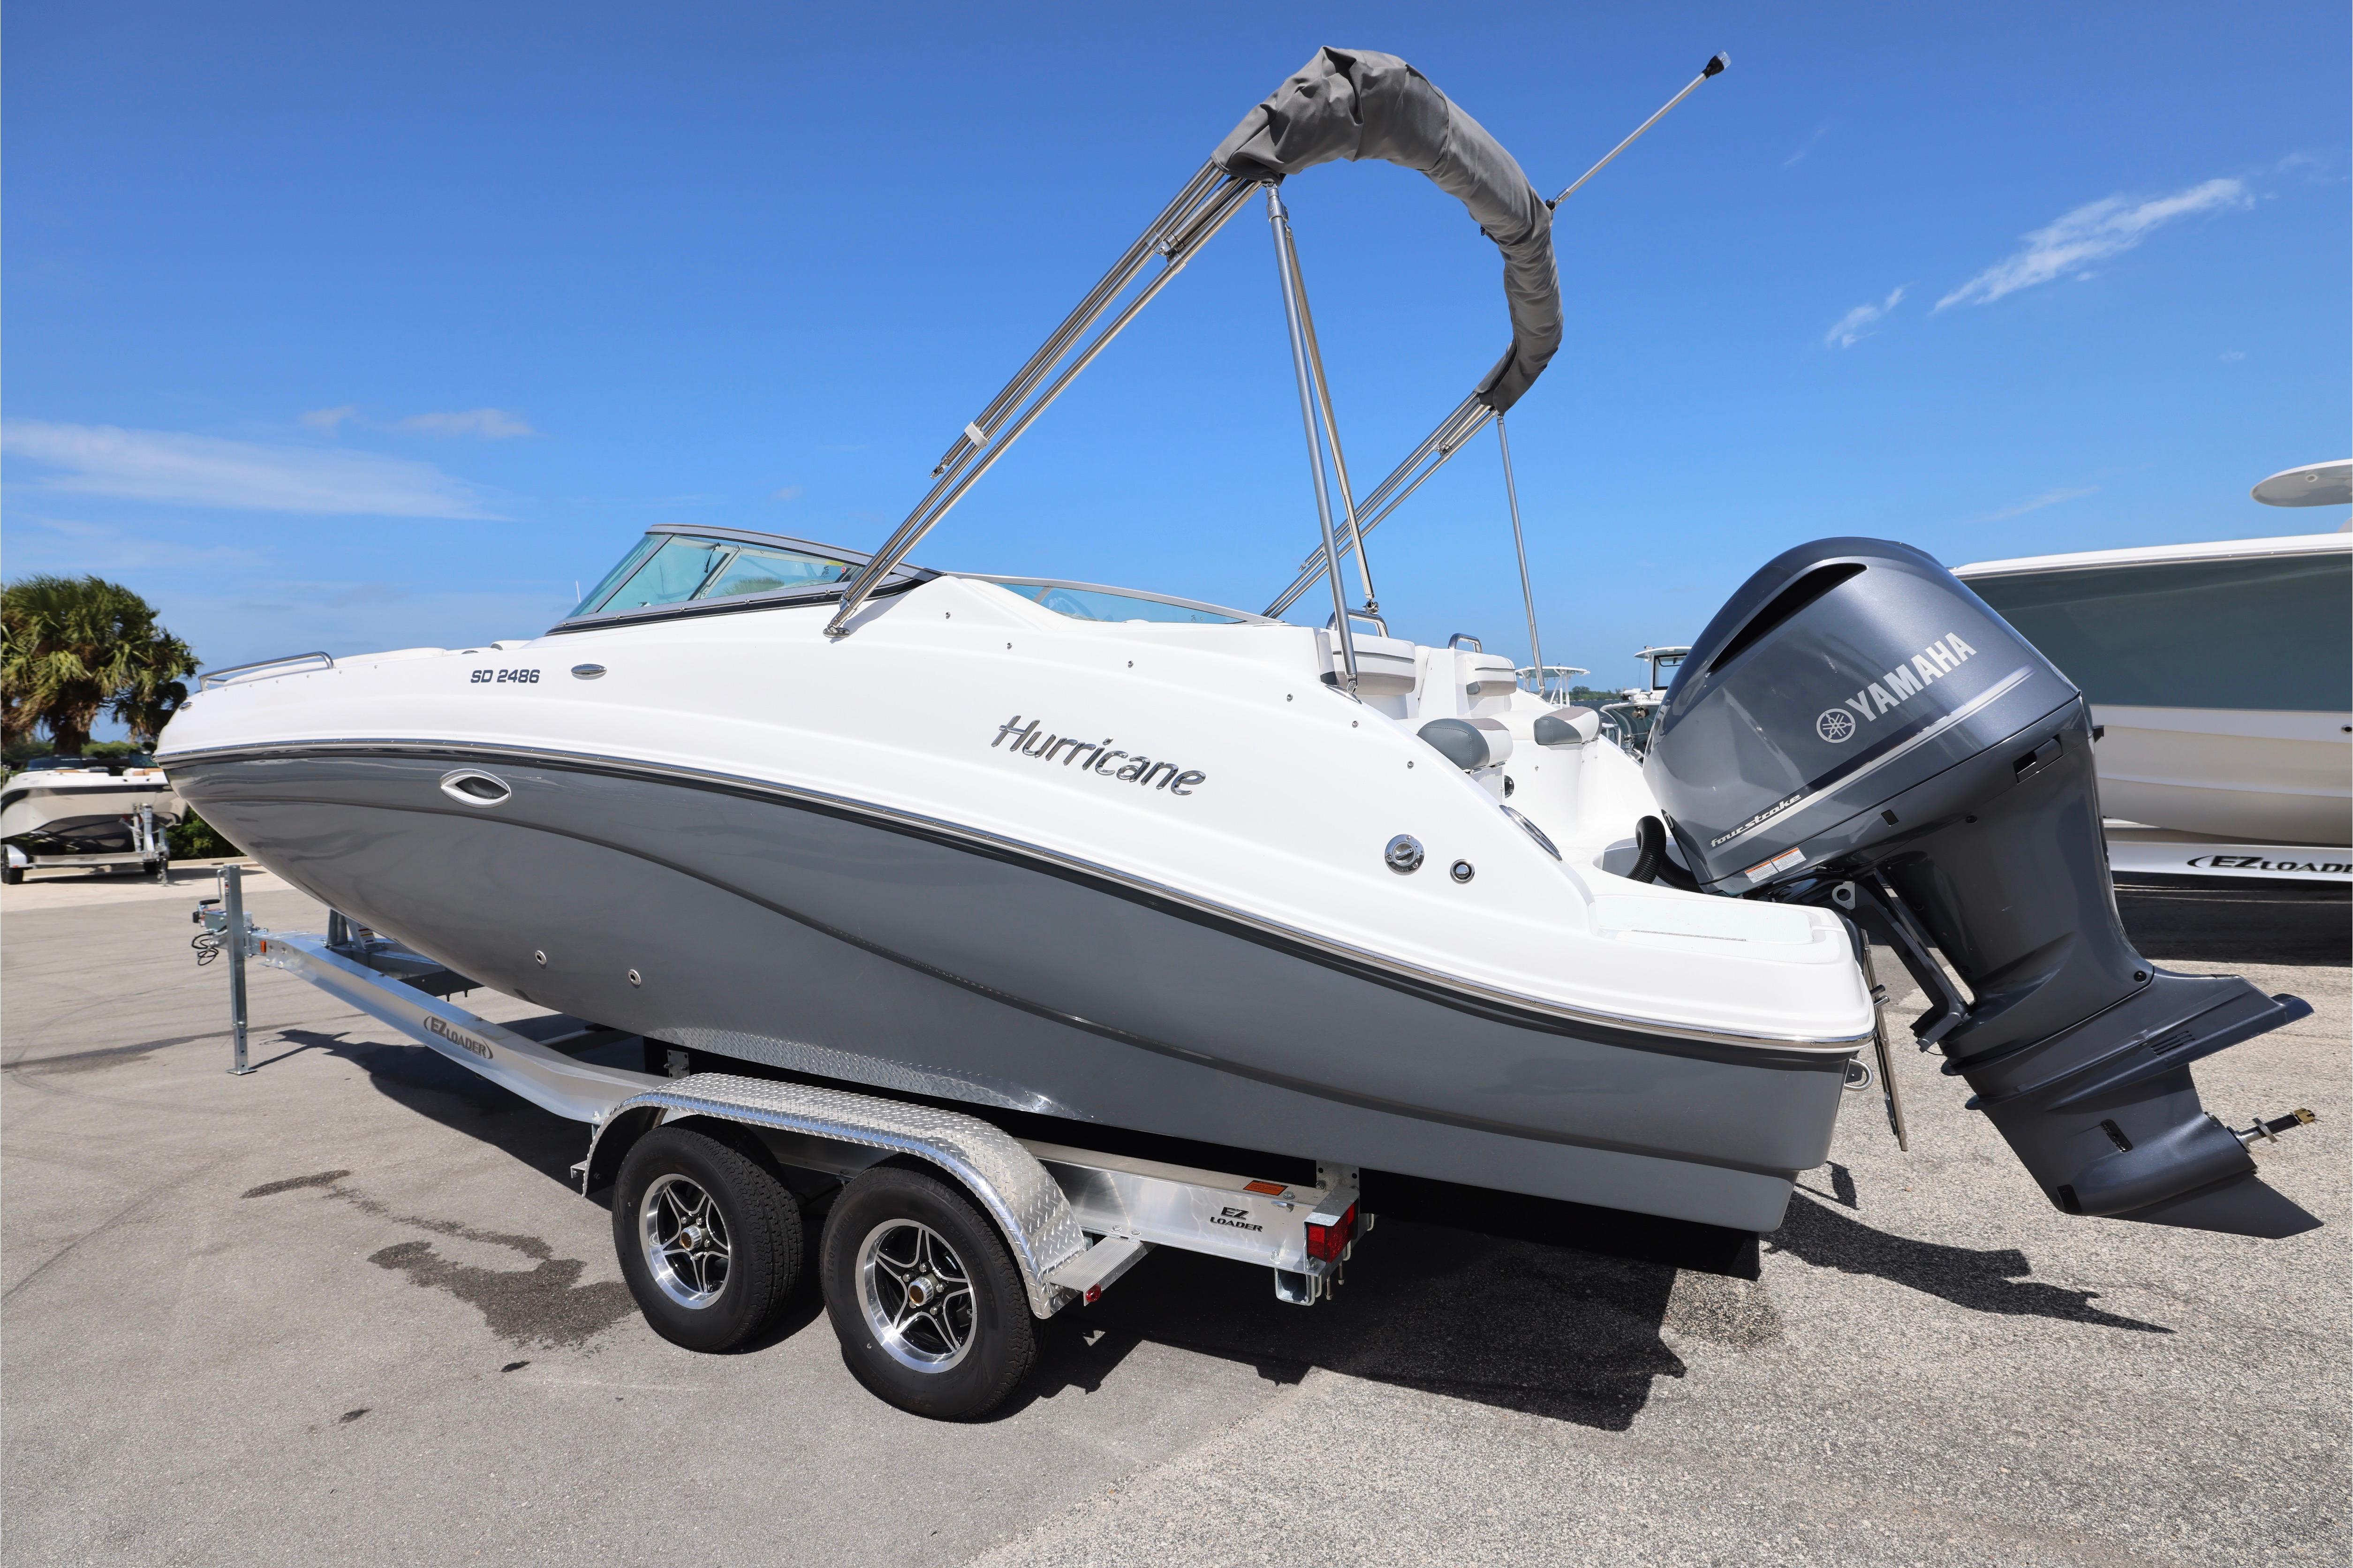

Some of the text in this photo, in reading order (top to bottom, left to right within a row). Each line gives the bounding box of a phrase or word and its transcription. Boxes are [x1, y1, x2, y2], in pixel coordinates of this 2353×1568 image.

[470, 669, 540, 683] SD 2486
[1845, 632, 1977, 722] YAMAHA
[991, 715, 1206, 796] Hurricane
[1220, 1206, 1249, 1221] EZ
[1210, 1216, 1263, 1233] LOADER
